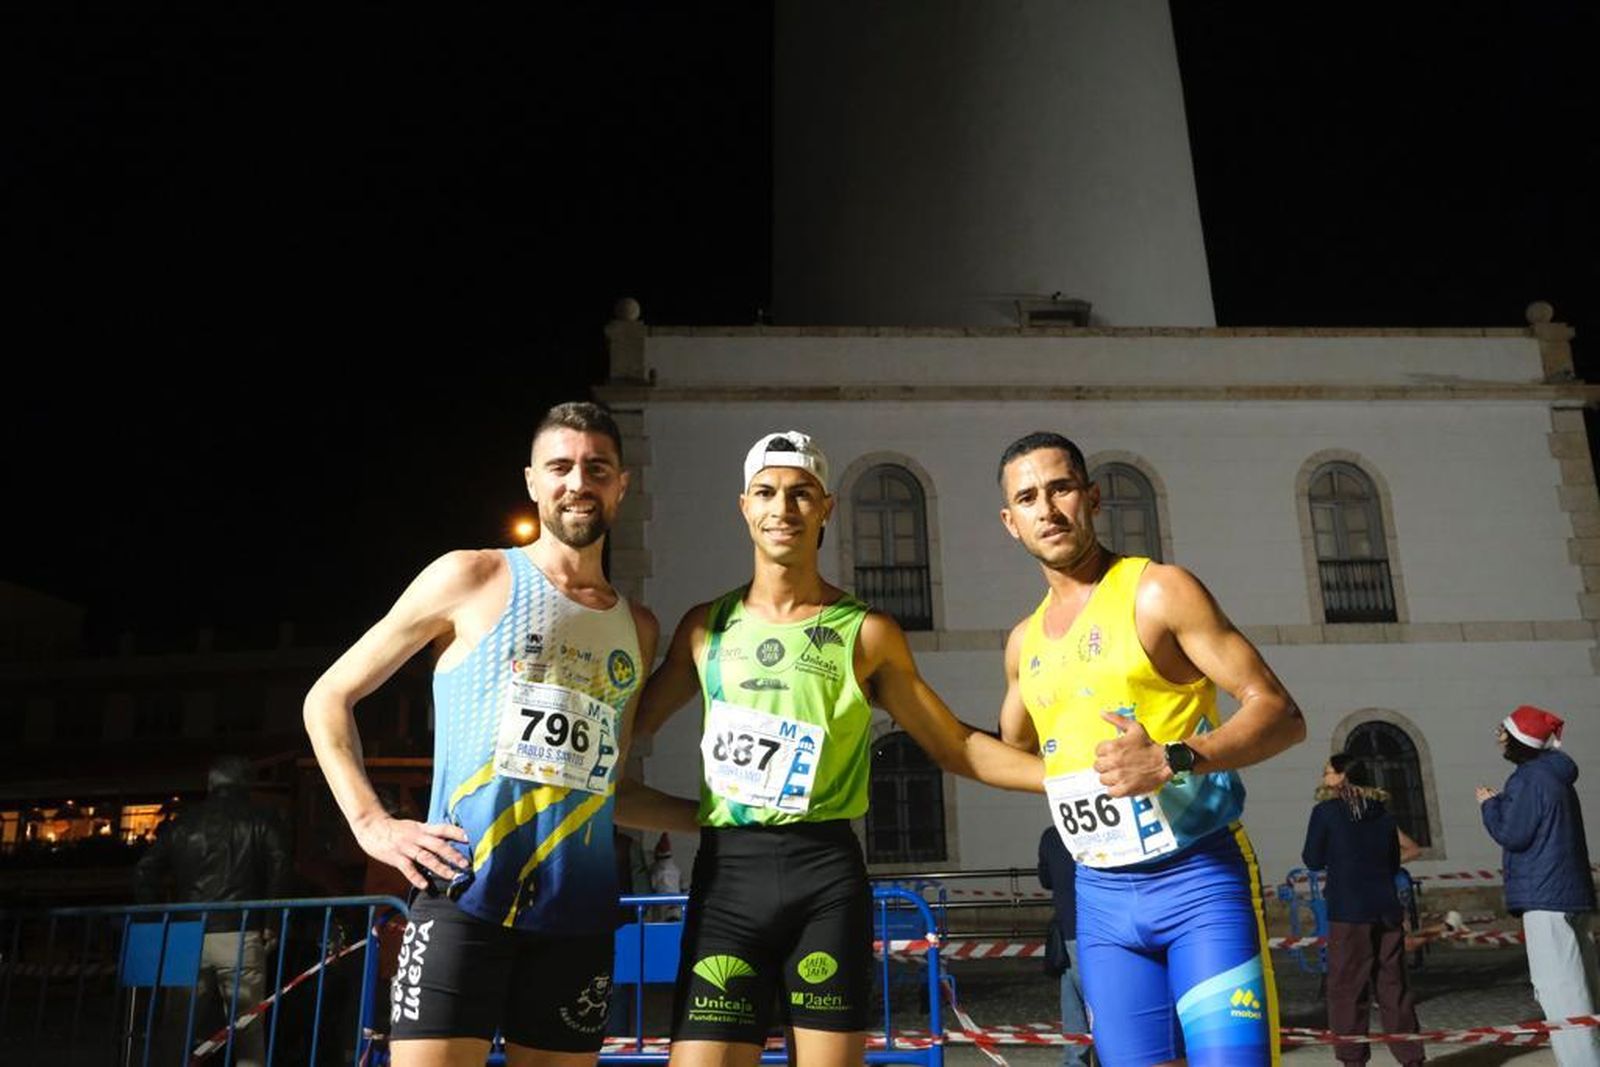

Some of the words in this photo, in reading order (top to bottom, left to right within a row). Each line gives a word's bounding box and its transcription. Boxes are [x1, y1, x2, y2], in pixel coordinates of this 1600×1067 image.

[800, 653, 838, 674] Unicaja
[521, 708, 590, 753] 796
[517, 743, 544, 758] PABLO
[713, 731, 781, 771] 887
[1059, 793, 1121, 835] 856
[695, 996, 753, 1013] Unicaja
